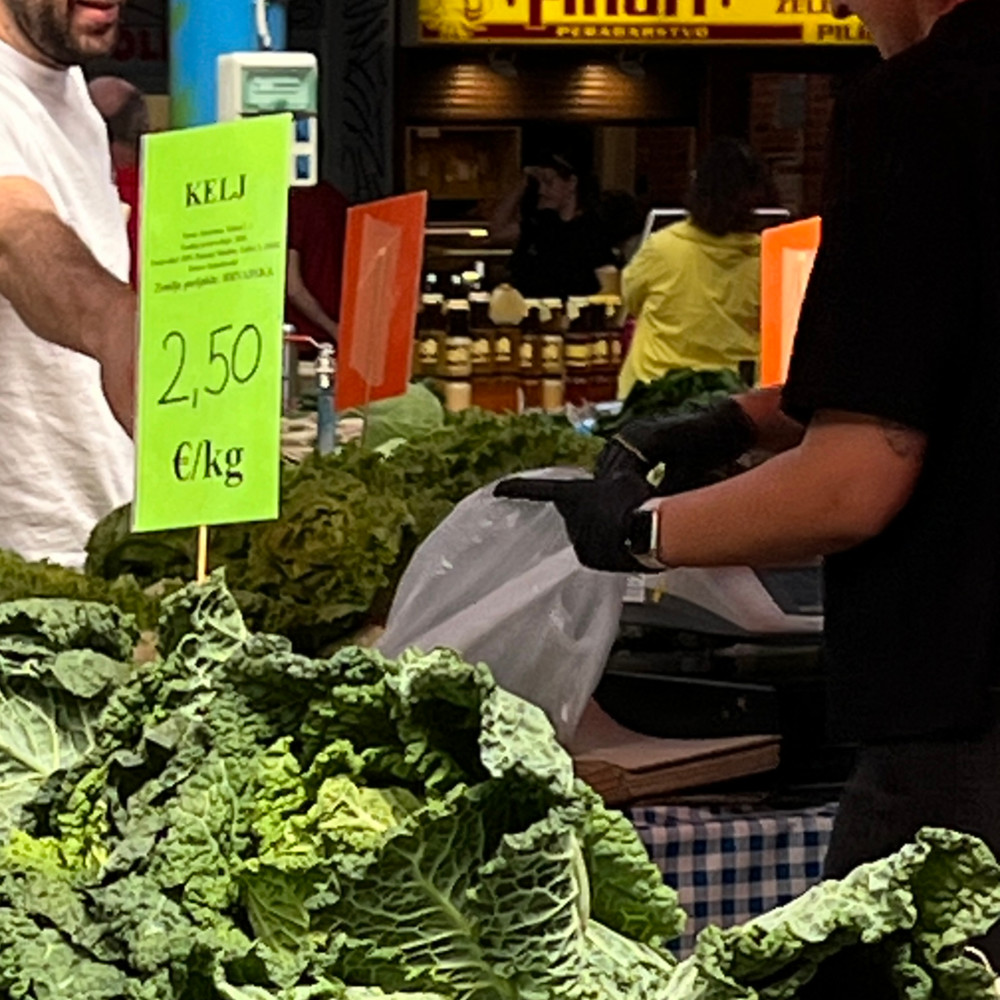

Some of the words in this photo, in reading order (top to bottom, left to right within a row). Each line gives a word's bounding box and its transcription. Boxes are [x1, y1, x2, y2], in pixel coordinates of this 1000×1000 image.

[185, 174, 247, 208] KELJ
[157, 323, 263, 409] 2,50
[172, 439, 245, 488] €/kg
